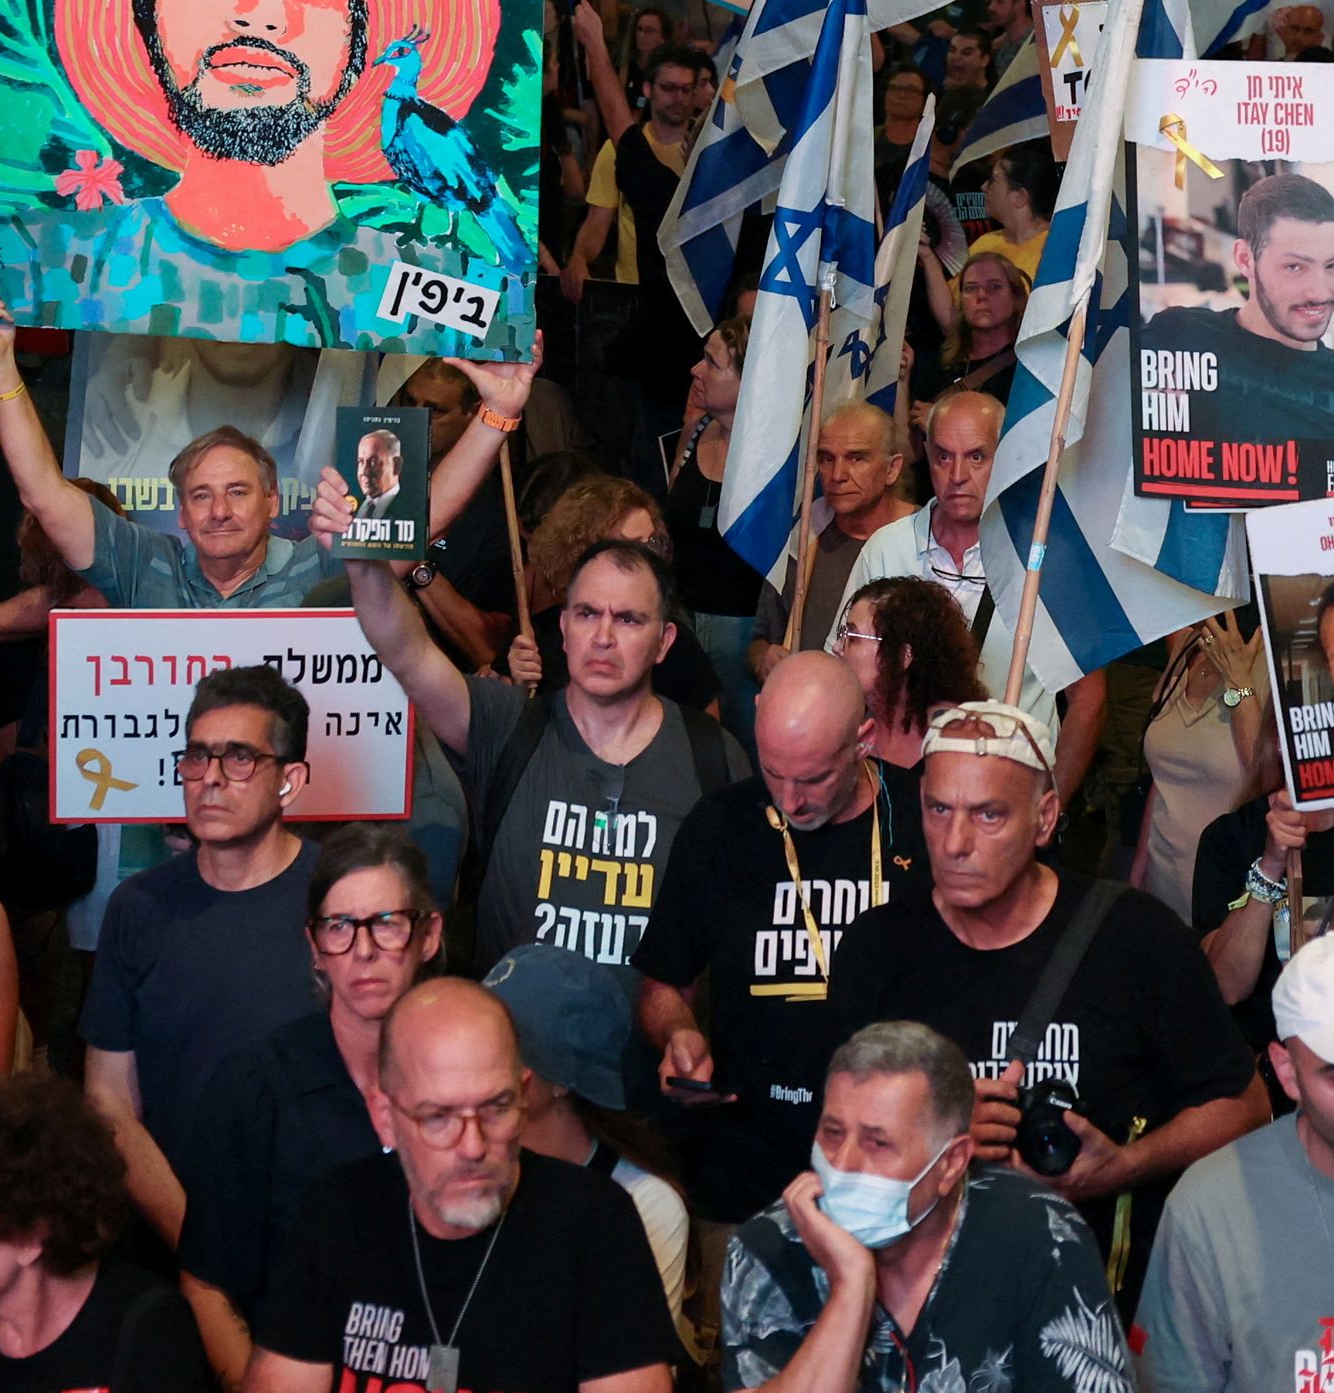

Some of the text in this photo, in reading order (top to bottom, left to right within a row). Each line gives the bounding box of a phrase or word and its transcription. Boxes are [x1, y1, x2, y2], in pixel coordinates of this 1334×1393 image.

[1246, 75, 1303, 101] איתי חן
[1237, 102, 1314, 127] ITAY CHEN
[1261, 128, 1291, 155] (19)
[389, 271, 487, 328] ביפין
[1141, 349, 1219, 392] BRING
[1142, 393, 1190, 432] HIM
[1142, 438, 1299, 485] HOME NOW!
[394, 520, 415, 542] מר
[61, 709, 403, 740] אינה לגבורת
[1293, 731, 1332, 761] HIM
[542, 800, 657, 858] למה הם
[537, 849, 655, 908] עדיין
[345, 1302, 405, 1342] BRING
